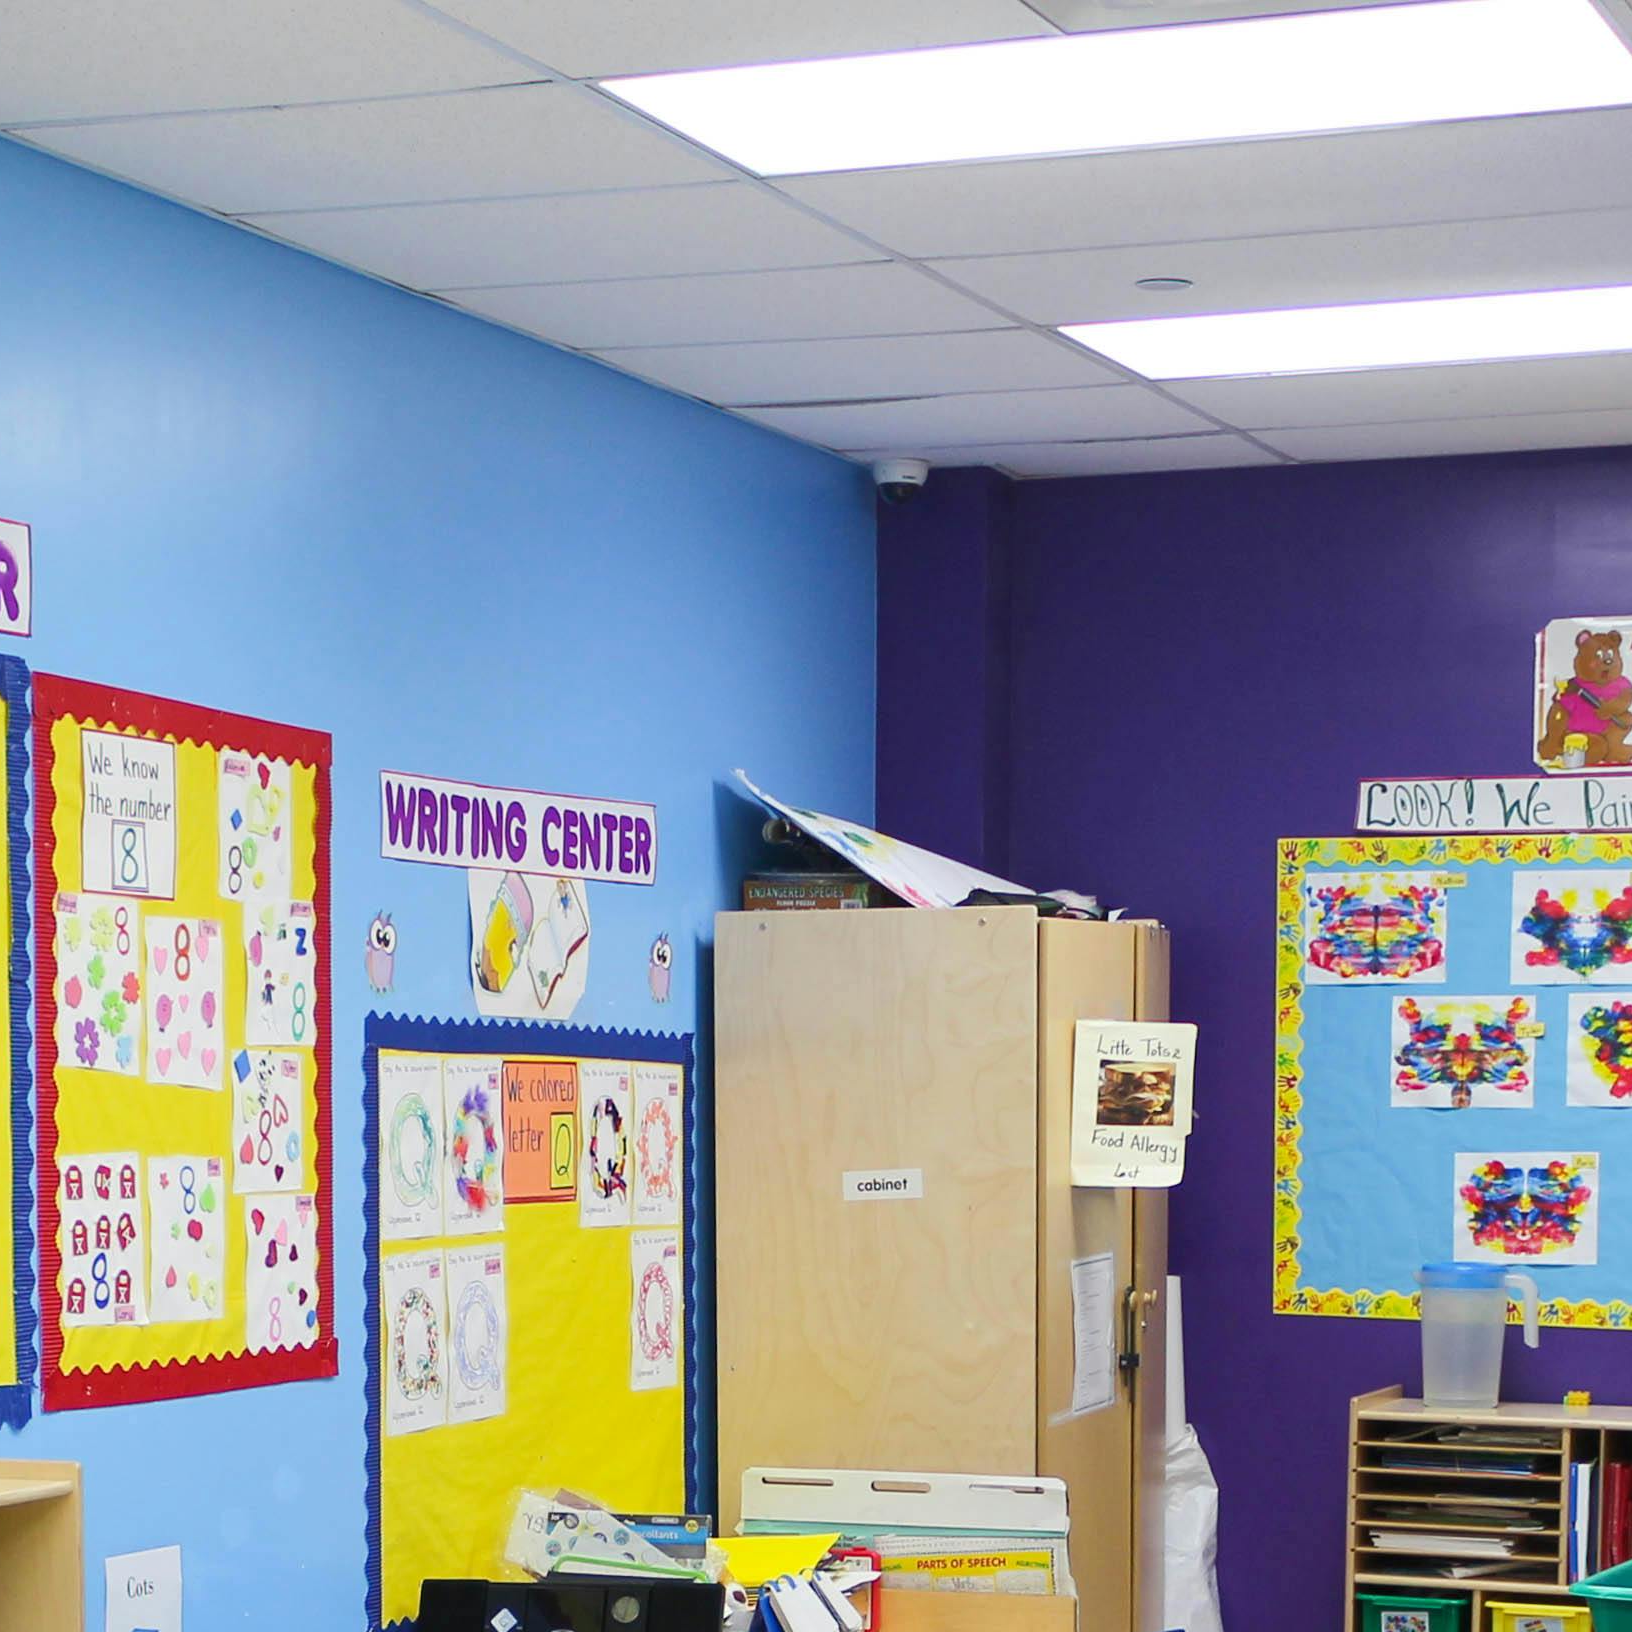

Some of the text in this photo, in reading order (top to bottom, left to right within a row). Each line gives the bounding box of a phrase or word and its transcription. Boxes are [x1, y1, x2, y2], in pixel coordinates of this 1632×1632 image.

[88, 742, 159, 781] We know
[89, 783, 172, 822] the number
[1366, 778, 1475, 828] LOOK!
[1495, 780, 1555, 826] We
[385, 779, 652, 876] WRITING CENTER
[121, 827, 139, 884] 8
[229, 845, 242, 895] 8
[749, 884, 845, 900] ENDANGERED SPECIES
[115, 906, 130, 956] 8
[174, 923, 191, 981] 8
[292, 982, 306, 1042] 8
[505, 1068, 526, 1102] We
[529, 1068, 575, 1102] colored
[258, 1110, 272, 1166] 8
[507, 1117, 571, 1176] letter Q
[1091, 1128, 1178, 1164] Food Allergy
[179, 1165, 196, 1214] 8
[857, 1177, 908, 1194] cabinet
[91, 1252, 110, 1310] 8
[269, 1297, 282, 1342] 8
[126, 1575, 155, 1599] Cots
[916, 1557, 1007, 1570] PARTS OF SPEECH
